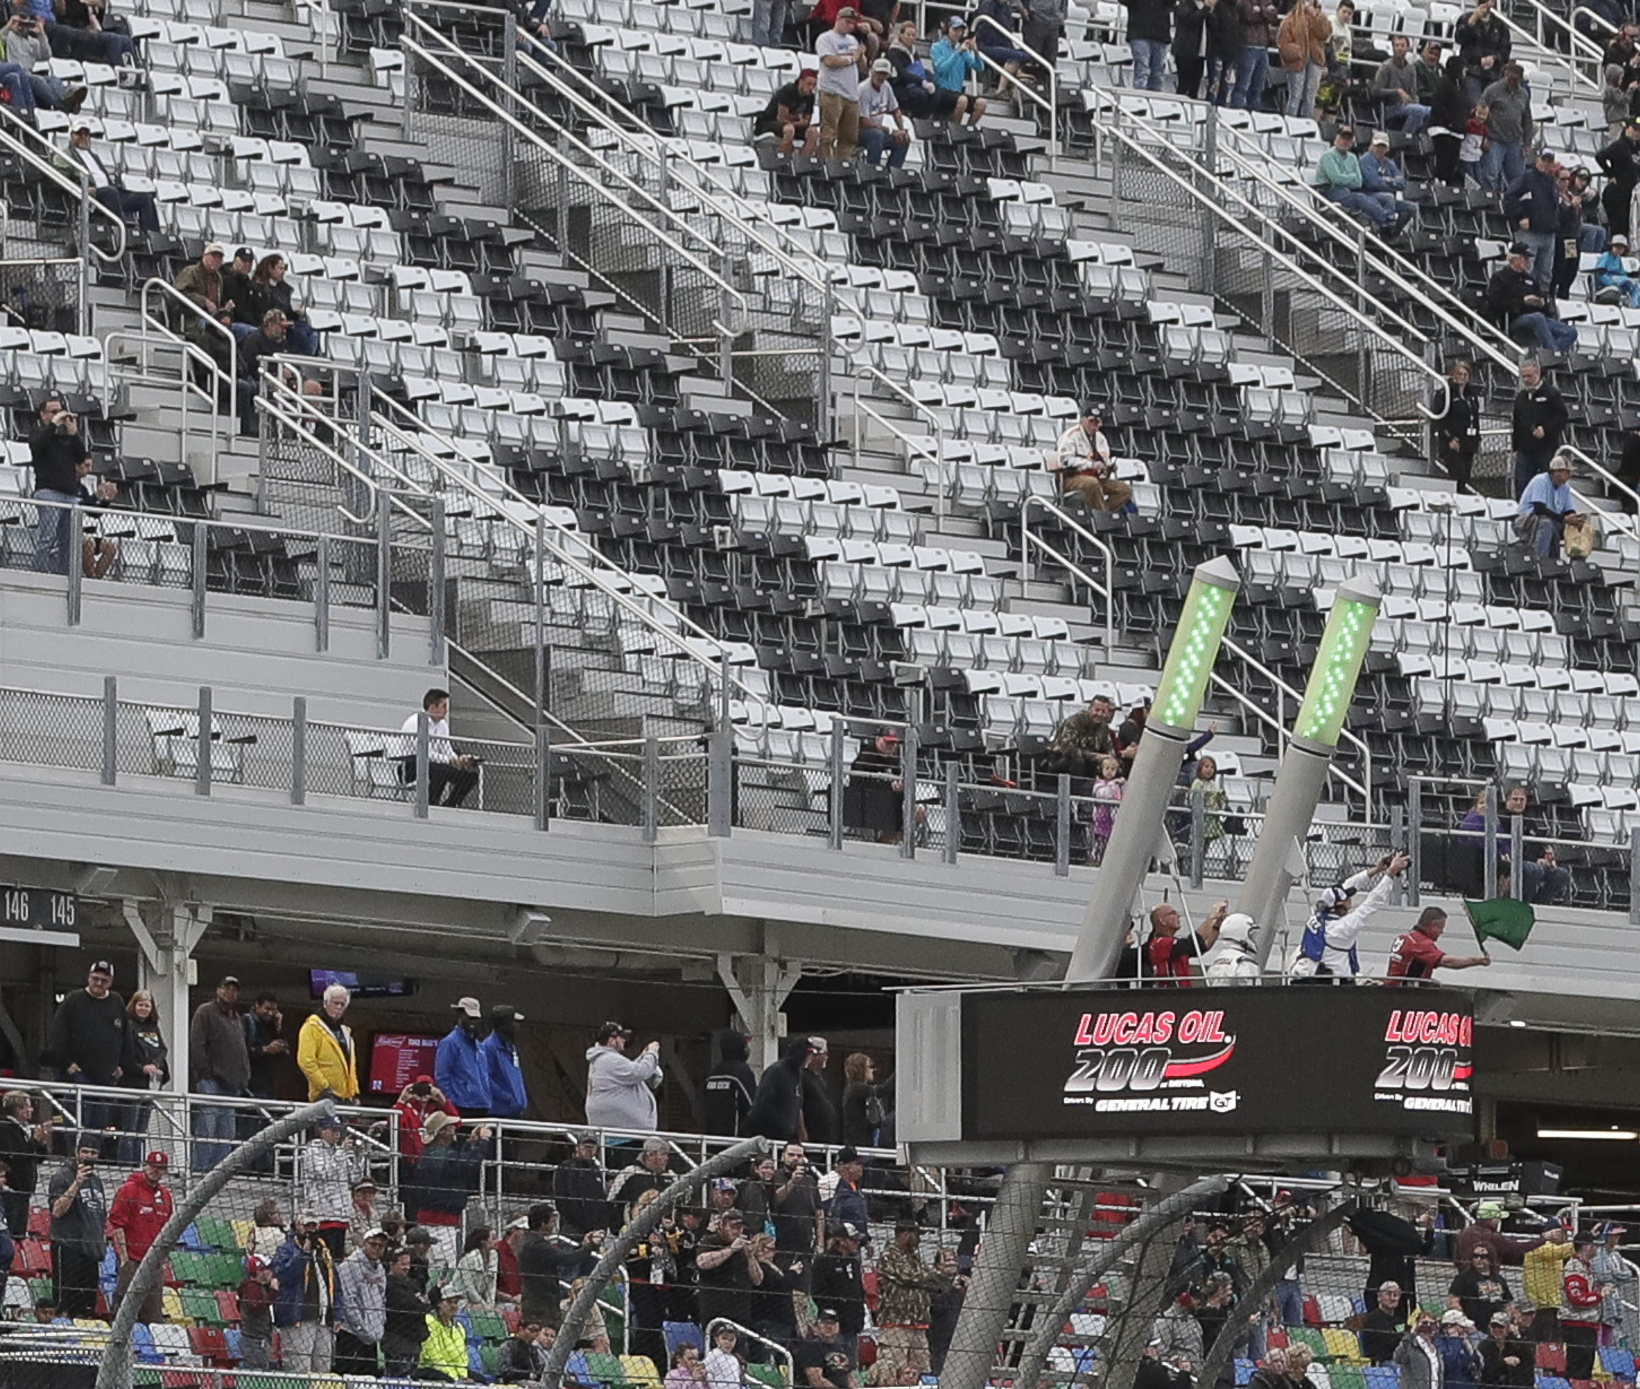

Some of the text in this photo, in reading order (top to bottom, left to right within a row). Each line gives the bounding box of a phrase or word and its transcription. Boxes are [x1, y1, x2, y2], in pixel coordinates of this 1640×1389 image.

[4, 890, 75, 926] 146 145
[1074, 1011, 1175, 1046] LUCAS
[1385, 1010, 1459, 1045] LUCAS
[1064, 1047, 1171, 1092] 200
[1375, 1046, 1457, 1090] 200
[1095, 1098, 1170, 1112] GENERAL
[1171, 1097, 1209, 1110] TIRE
[1472, 1179, 1519, 1192] WHELEN
